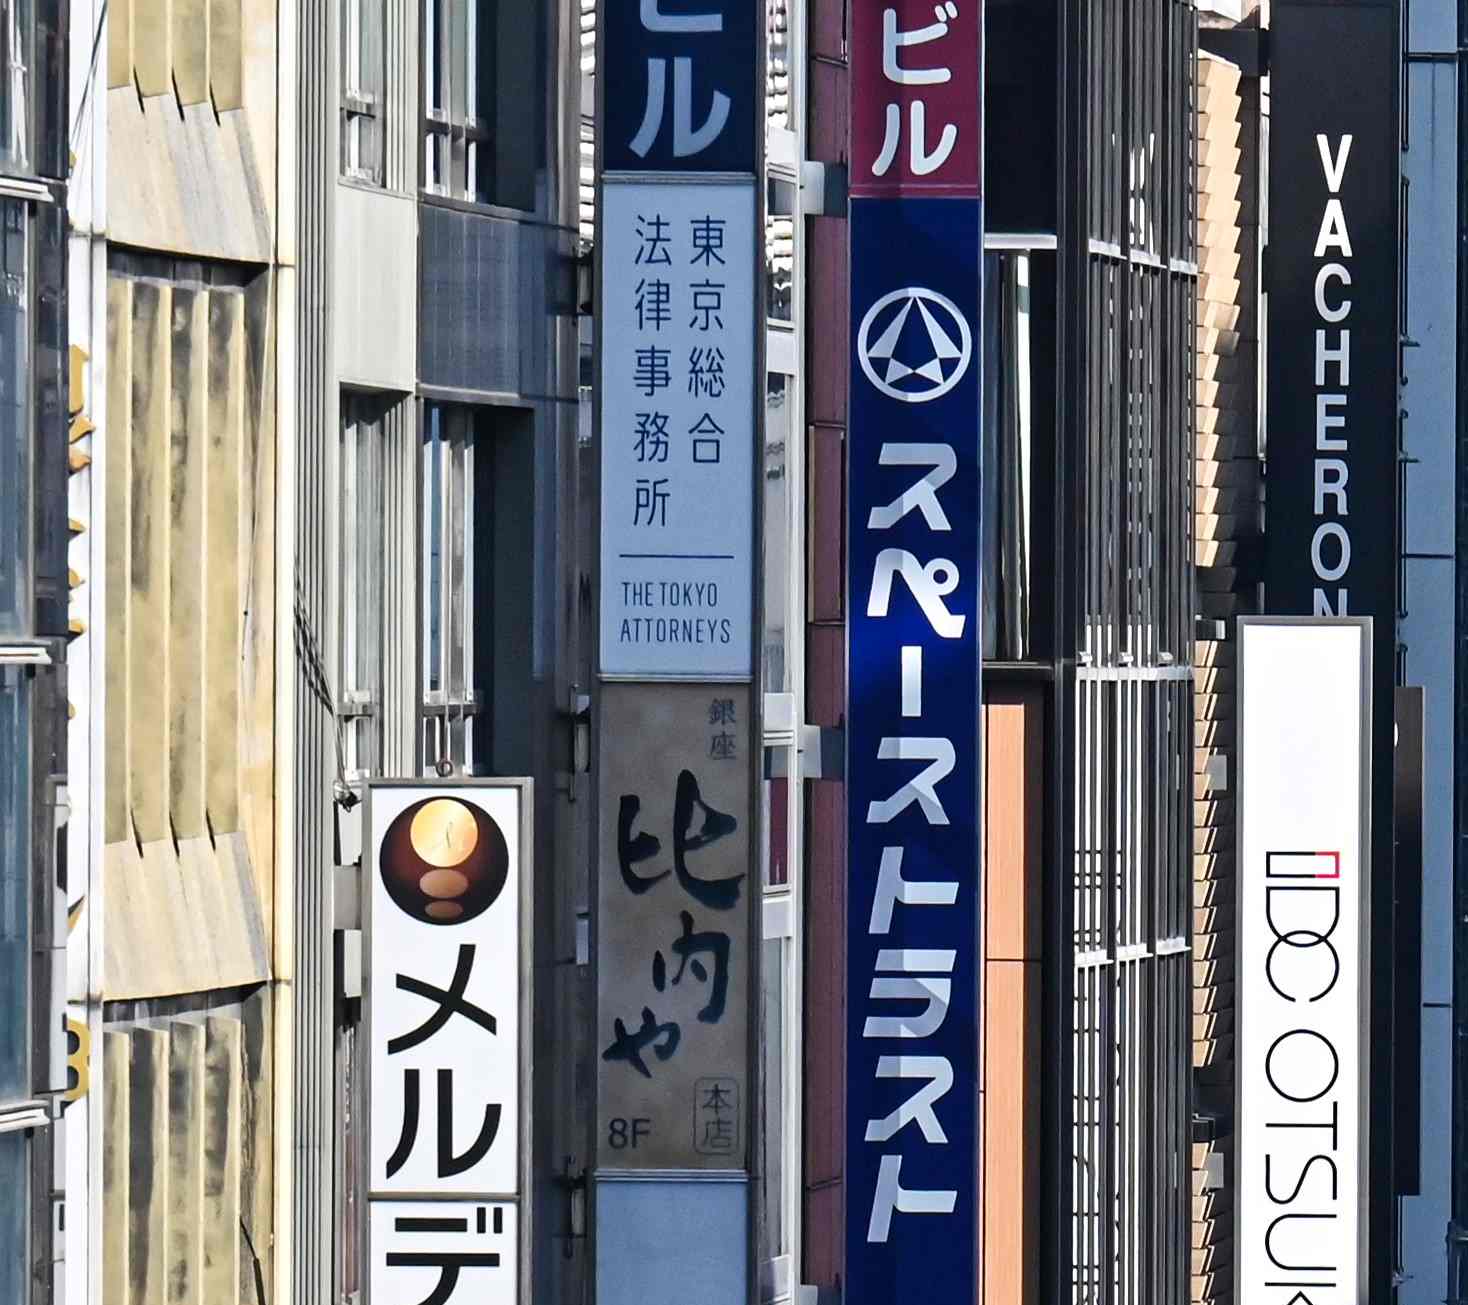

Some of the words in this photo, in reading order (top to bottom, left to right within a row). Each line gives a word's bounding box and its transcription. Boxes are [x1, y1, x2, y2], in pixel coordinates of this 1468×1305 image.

[872, 2, 957, 176] ビル
[632, 214, 672, 528] 法律事務所
[687, 214, 726, 466] 東京総合
[619, 617, 731, 644] ATTORNEYS
[621, 582, 654, 607] THE
[659, 582, 718, 607] TOKYO
[707, 697, 737, 761] 銀座
[863, 442, 966, 1243] スペーストラスト
[602, 768, 746, 1080] 比内や
[608, 1117, 650, 1149] 8F
[702, 1084, 732, 1150] 本店
